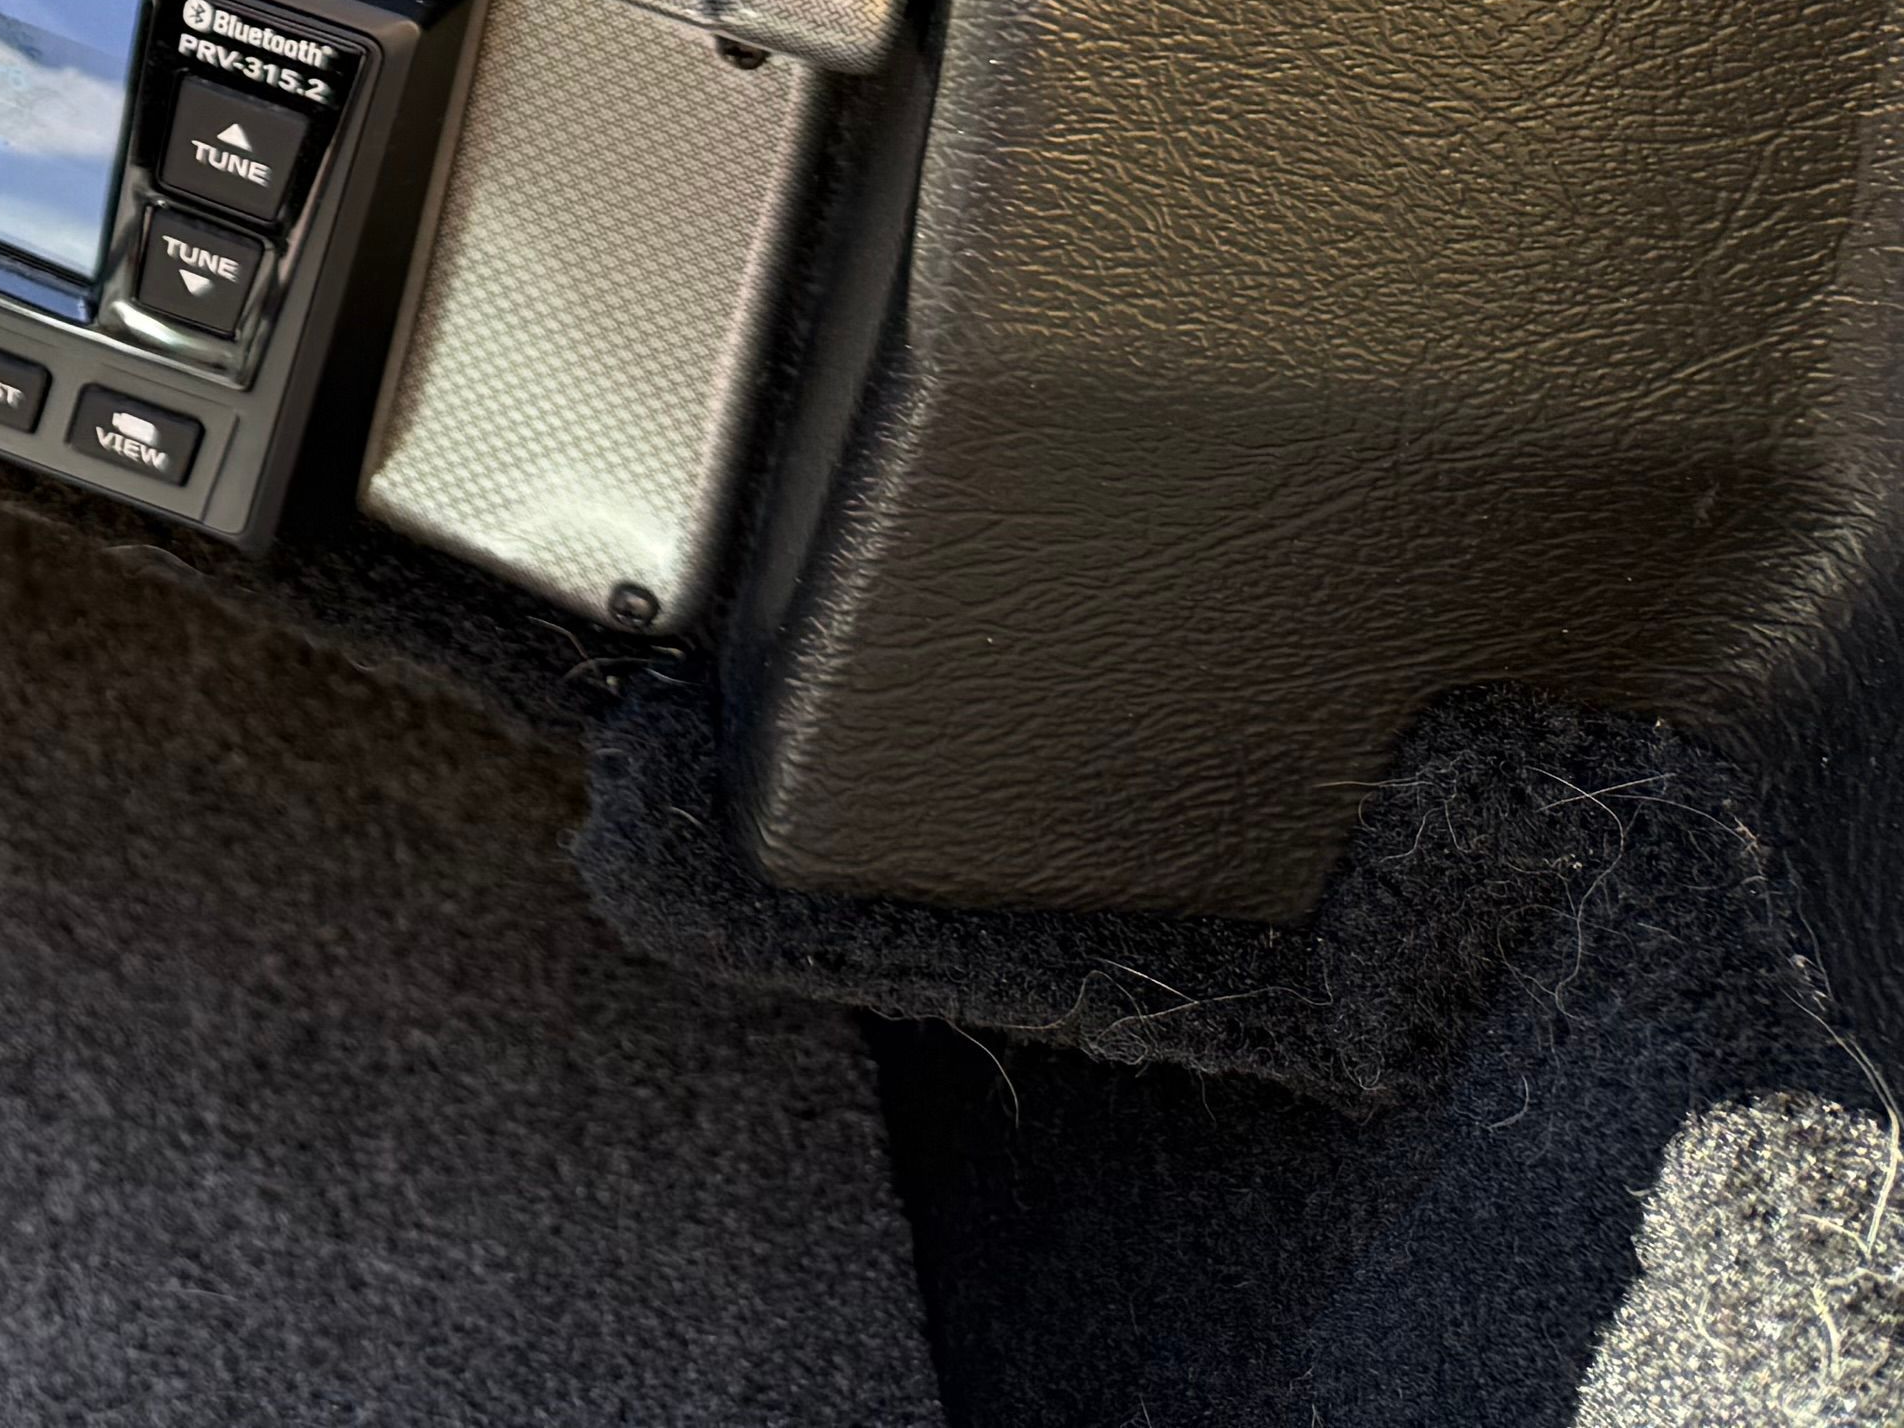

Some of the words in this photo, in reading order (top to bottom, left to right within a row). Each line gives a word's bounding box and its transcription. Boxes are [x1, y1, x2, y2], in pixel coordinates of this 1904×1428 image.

[178, 33, 333, 104] PRV-315.2
[192, 139, 272, 188] TUNE
[162, 234, 239, 284] TUNE
[96, 426, 170, 472] VIEW
